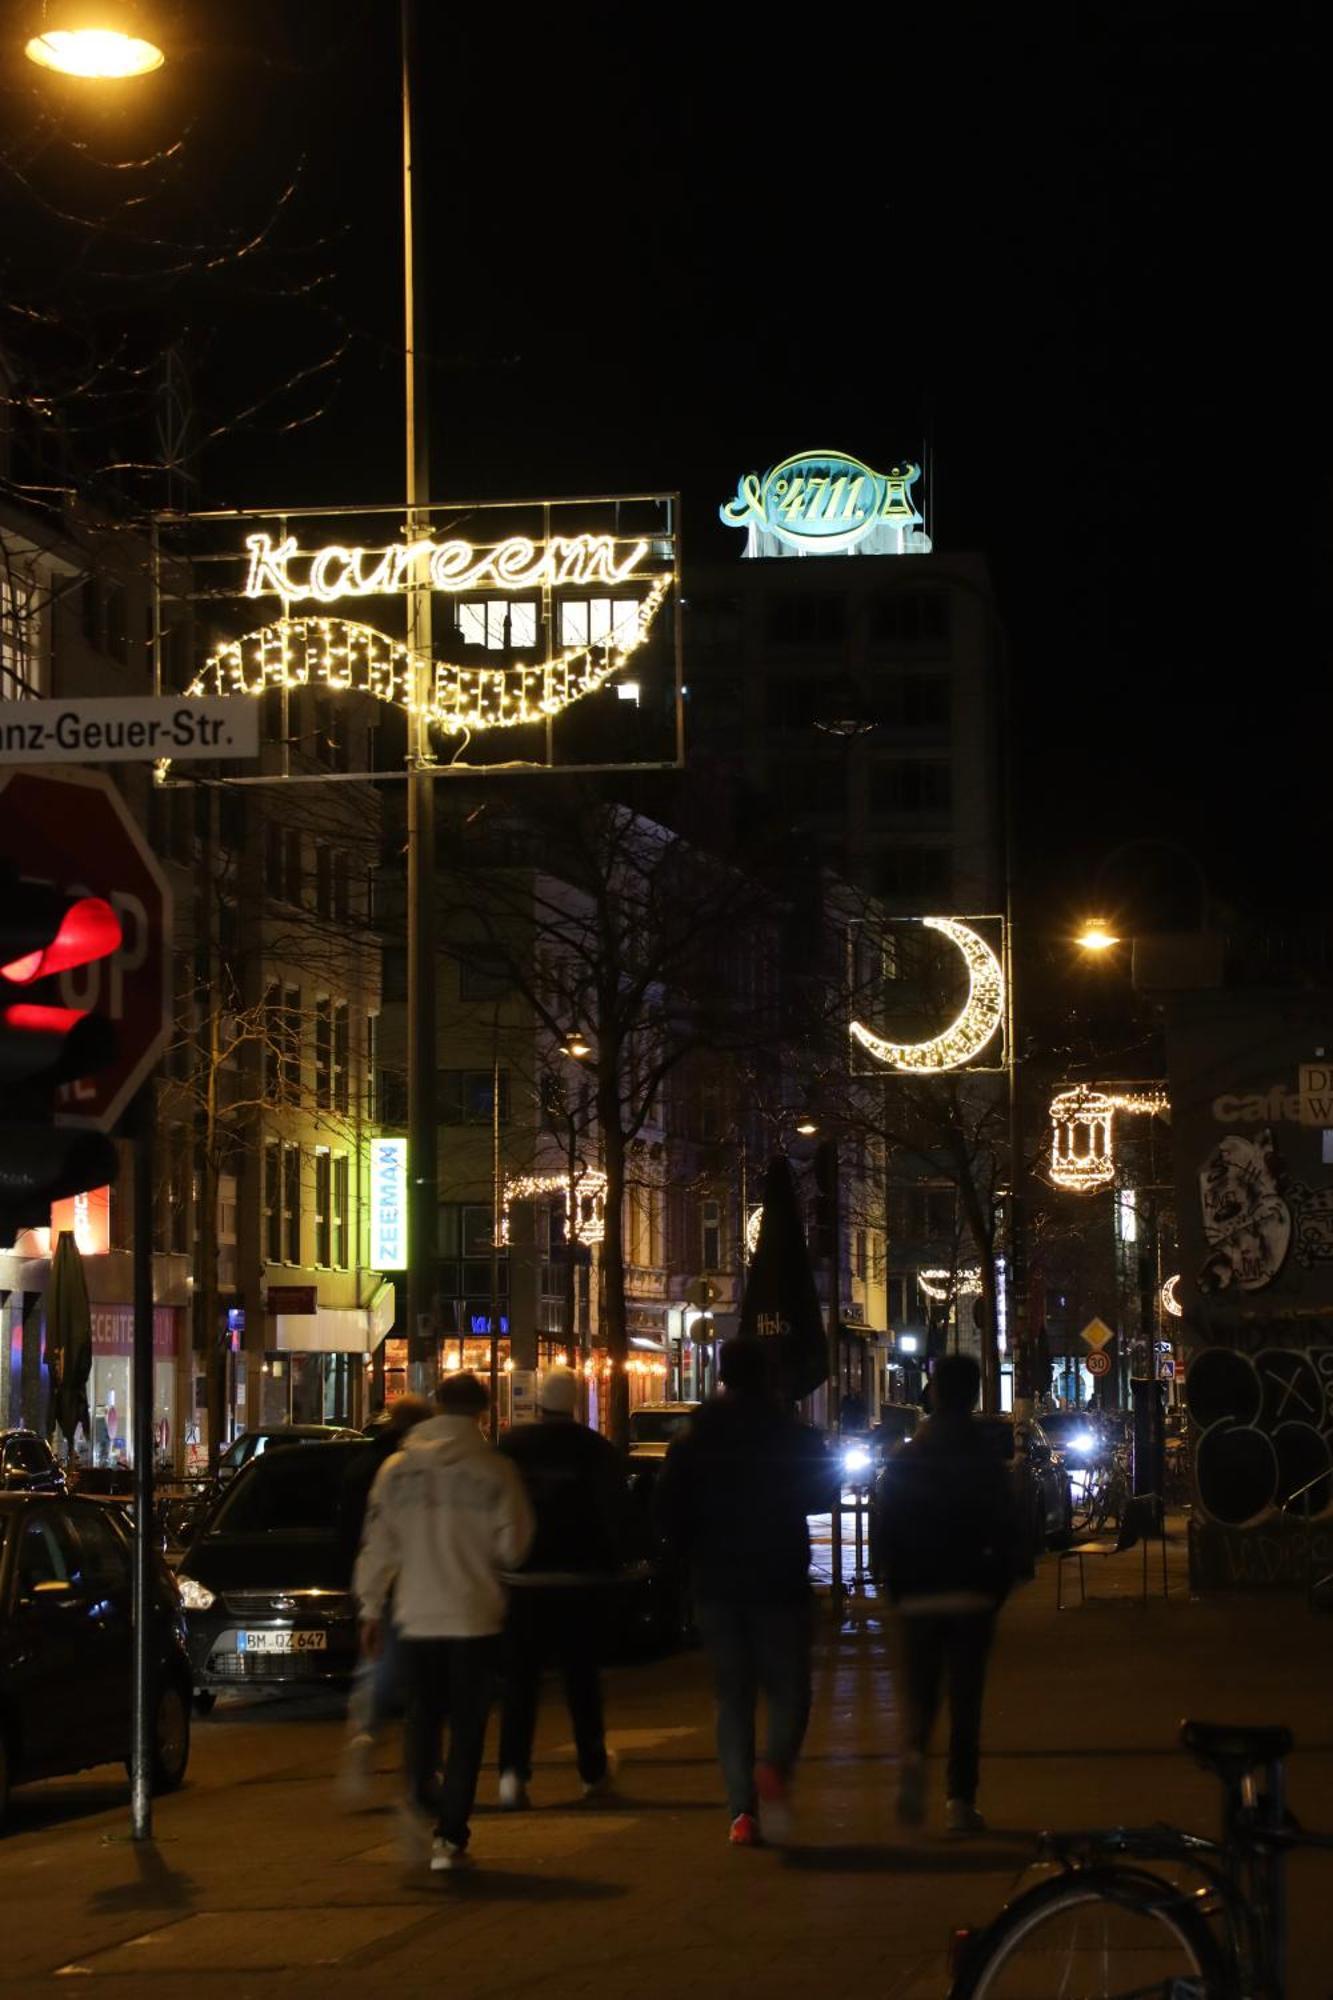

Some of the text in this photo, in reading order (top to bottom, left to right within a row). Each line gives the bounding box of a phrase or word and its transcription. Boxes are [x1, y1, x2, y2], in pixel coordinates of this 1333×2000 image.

[245, 534, 647, 600] Kareem
[0, 710, 232, 750] nz-Geuer-Str.
[380, 1146, 398, 1260] ZEEMAN
[91, 1313, 135, 1344] ECENTE
[1092, 1359, 1105, 1370] 30
[248, 1634, 266, 1649] BM
